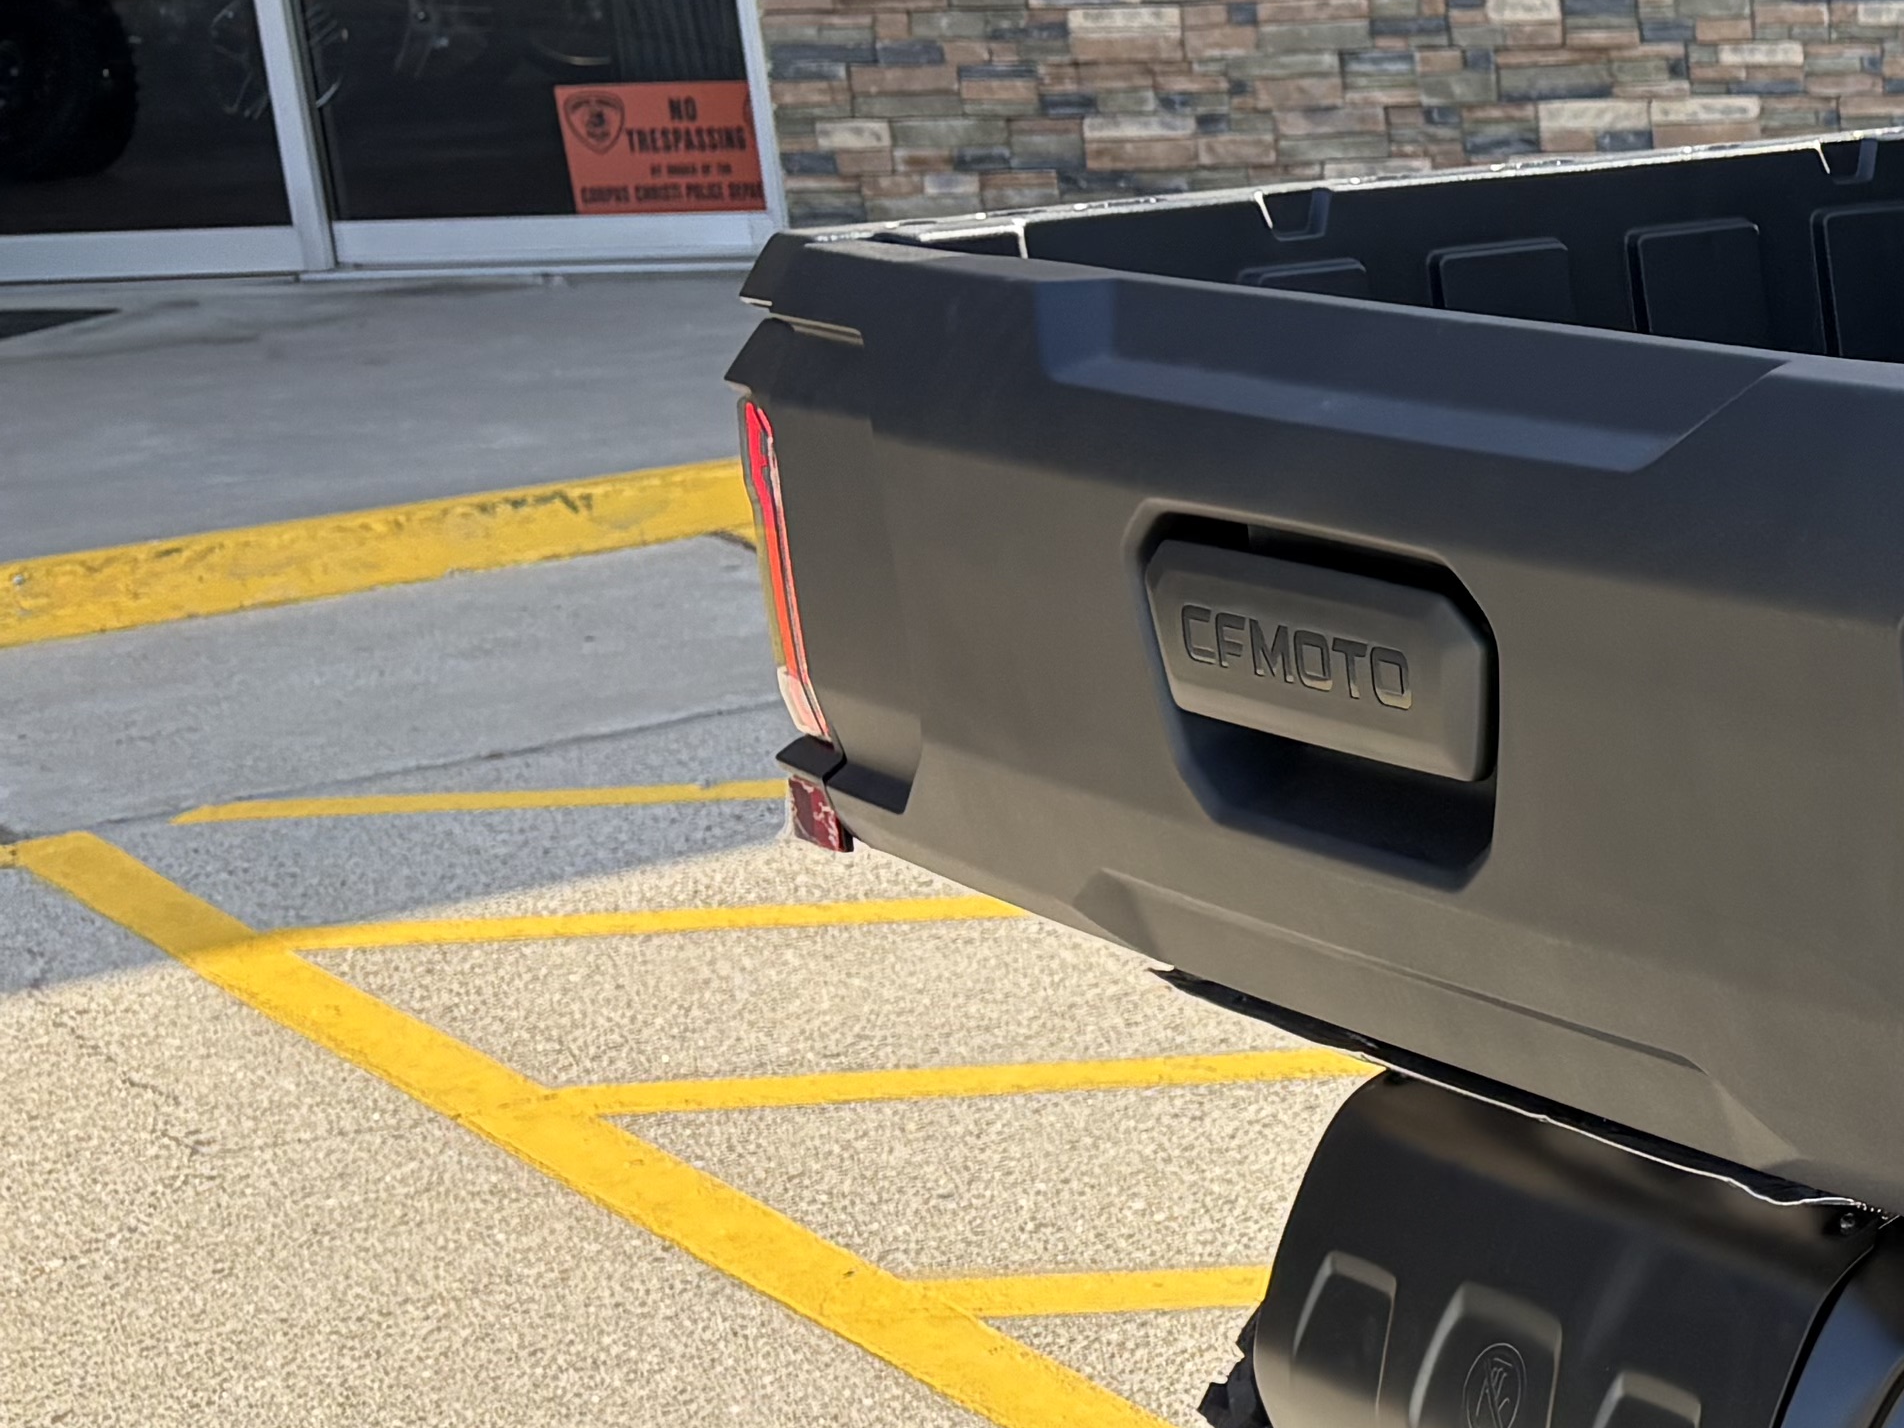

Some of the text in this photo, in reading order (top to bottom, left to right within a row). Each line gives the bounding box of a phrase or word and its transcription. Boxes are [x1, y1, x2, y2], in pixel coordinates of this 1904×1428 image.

[668, 96, 697, 122] NO
[626, 125, 747, 152] TRESPASSING
[1180, 603, 1413, 711] CFMOTO
